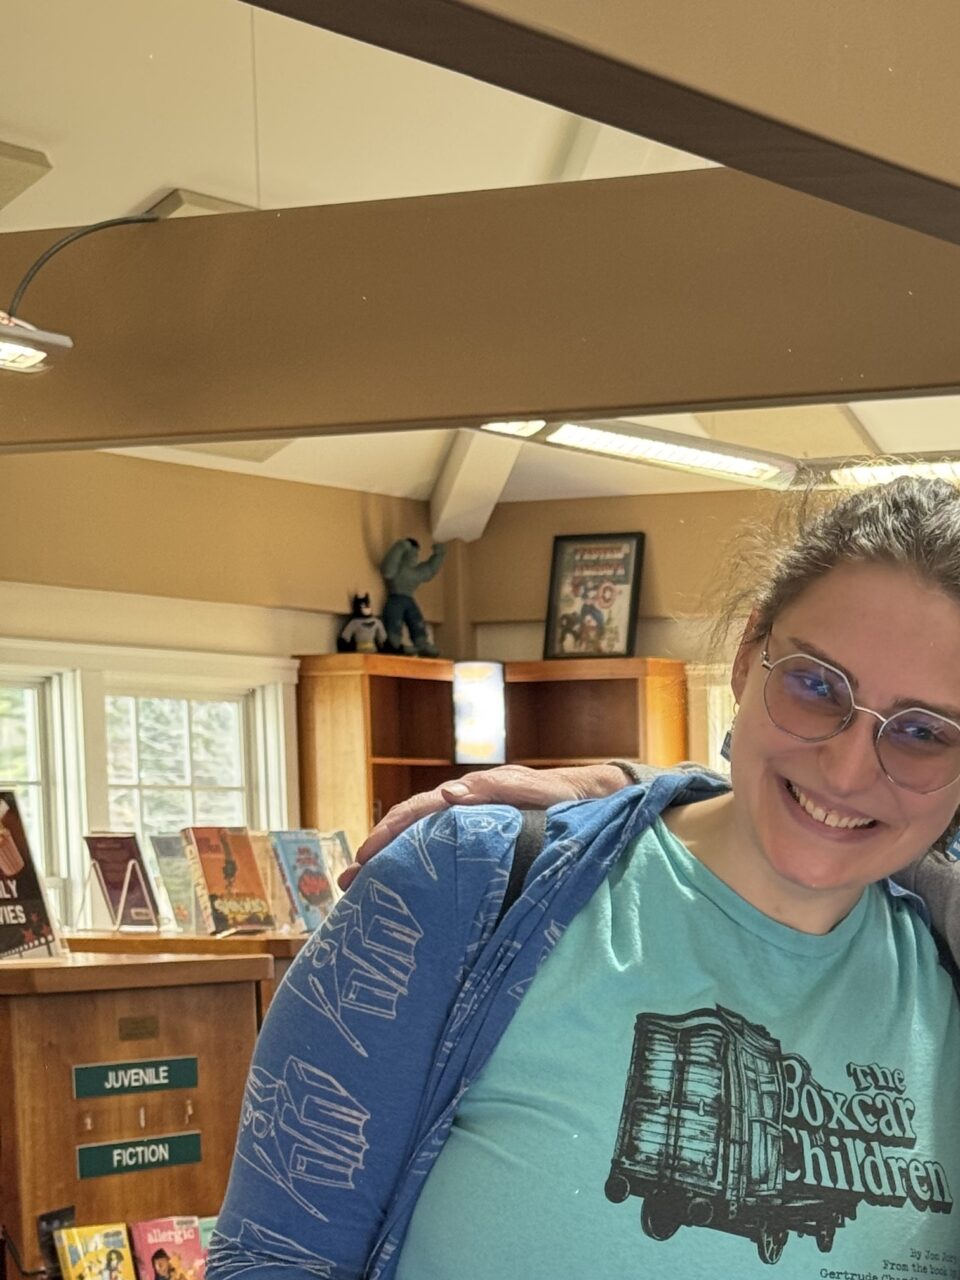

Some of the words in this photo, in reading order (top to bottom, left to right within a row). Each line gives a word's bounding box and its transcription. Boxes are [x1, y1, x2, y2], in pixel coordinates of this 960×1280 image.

[104, 1066, 169, 1089] JUVENILE
[846, 1061, 906, 1094] The
[782, 1056, 917, 1143] Boxcar
[112, 1143, 169, 1168] FICTION
[782, 1124, 953, 1208] Children
[147, 1228, 195, 1244] allergic
[910, 1248, 921, 1260] By
[882, 1259, 909, 1271] From
[911, 1262, 928, 1273] the
[929, 1265, 948, 1277] book
